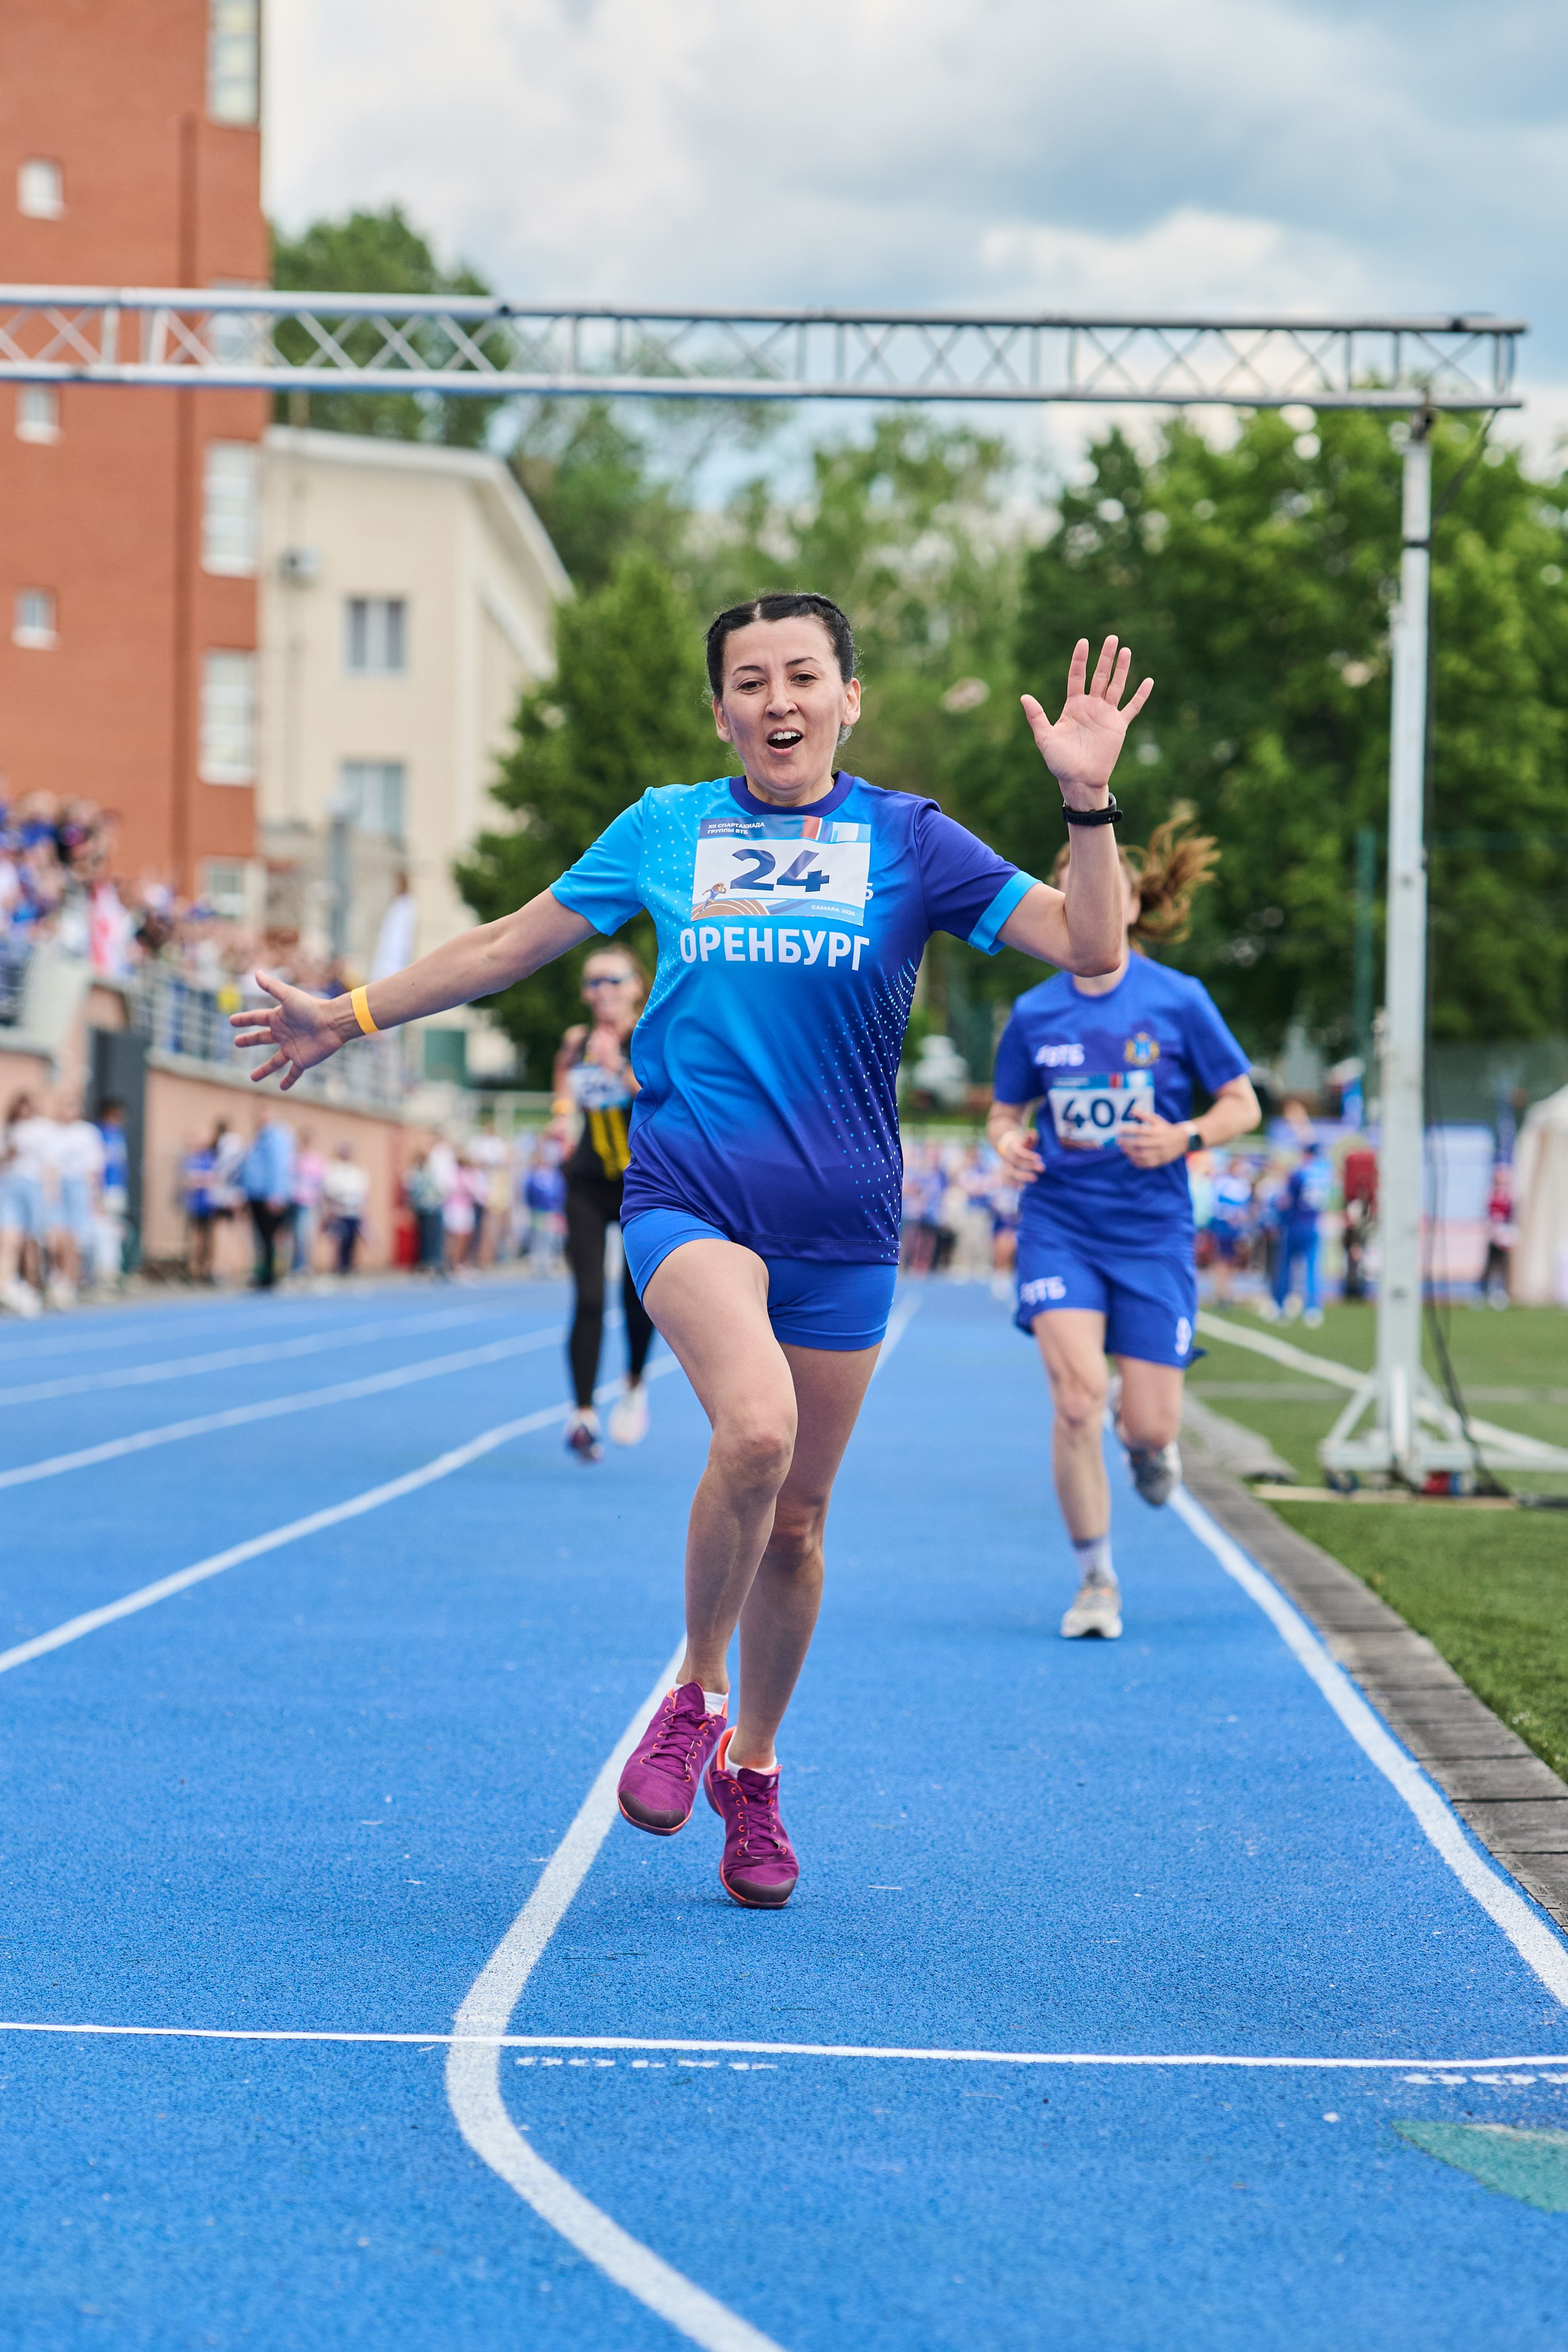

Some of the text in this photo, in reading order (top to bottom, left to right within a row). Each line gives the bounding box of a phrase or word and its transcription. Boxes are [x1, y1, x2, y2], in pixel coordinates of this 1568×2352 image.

[729, 848, 830, 892] 24
[679, 926, 870, 971] ОРЕНБУРГ
[1061, 1098, 1143, 1129] 404
